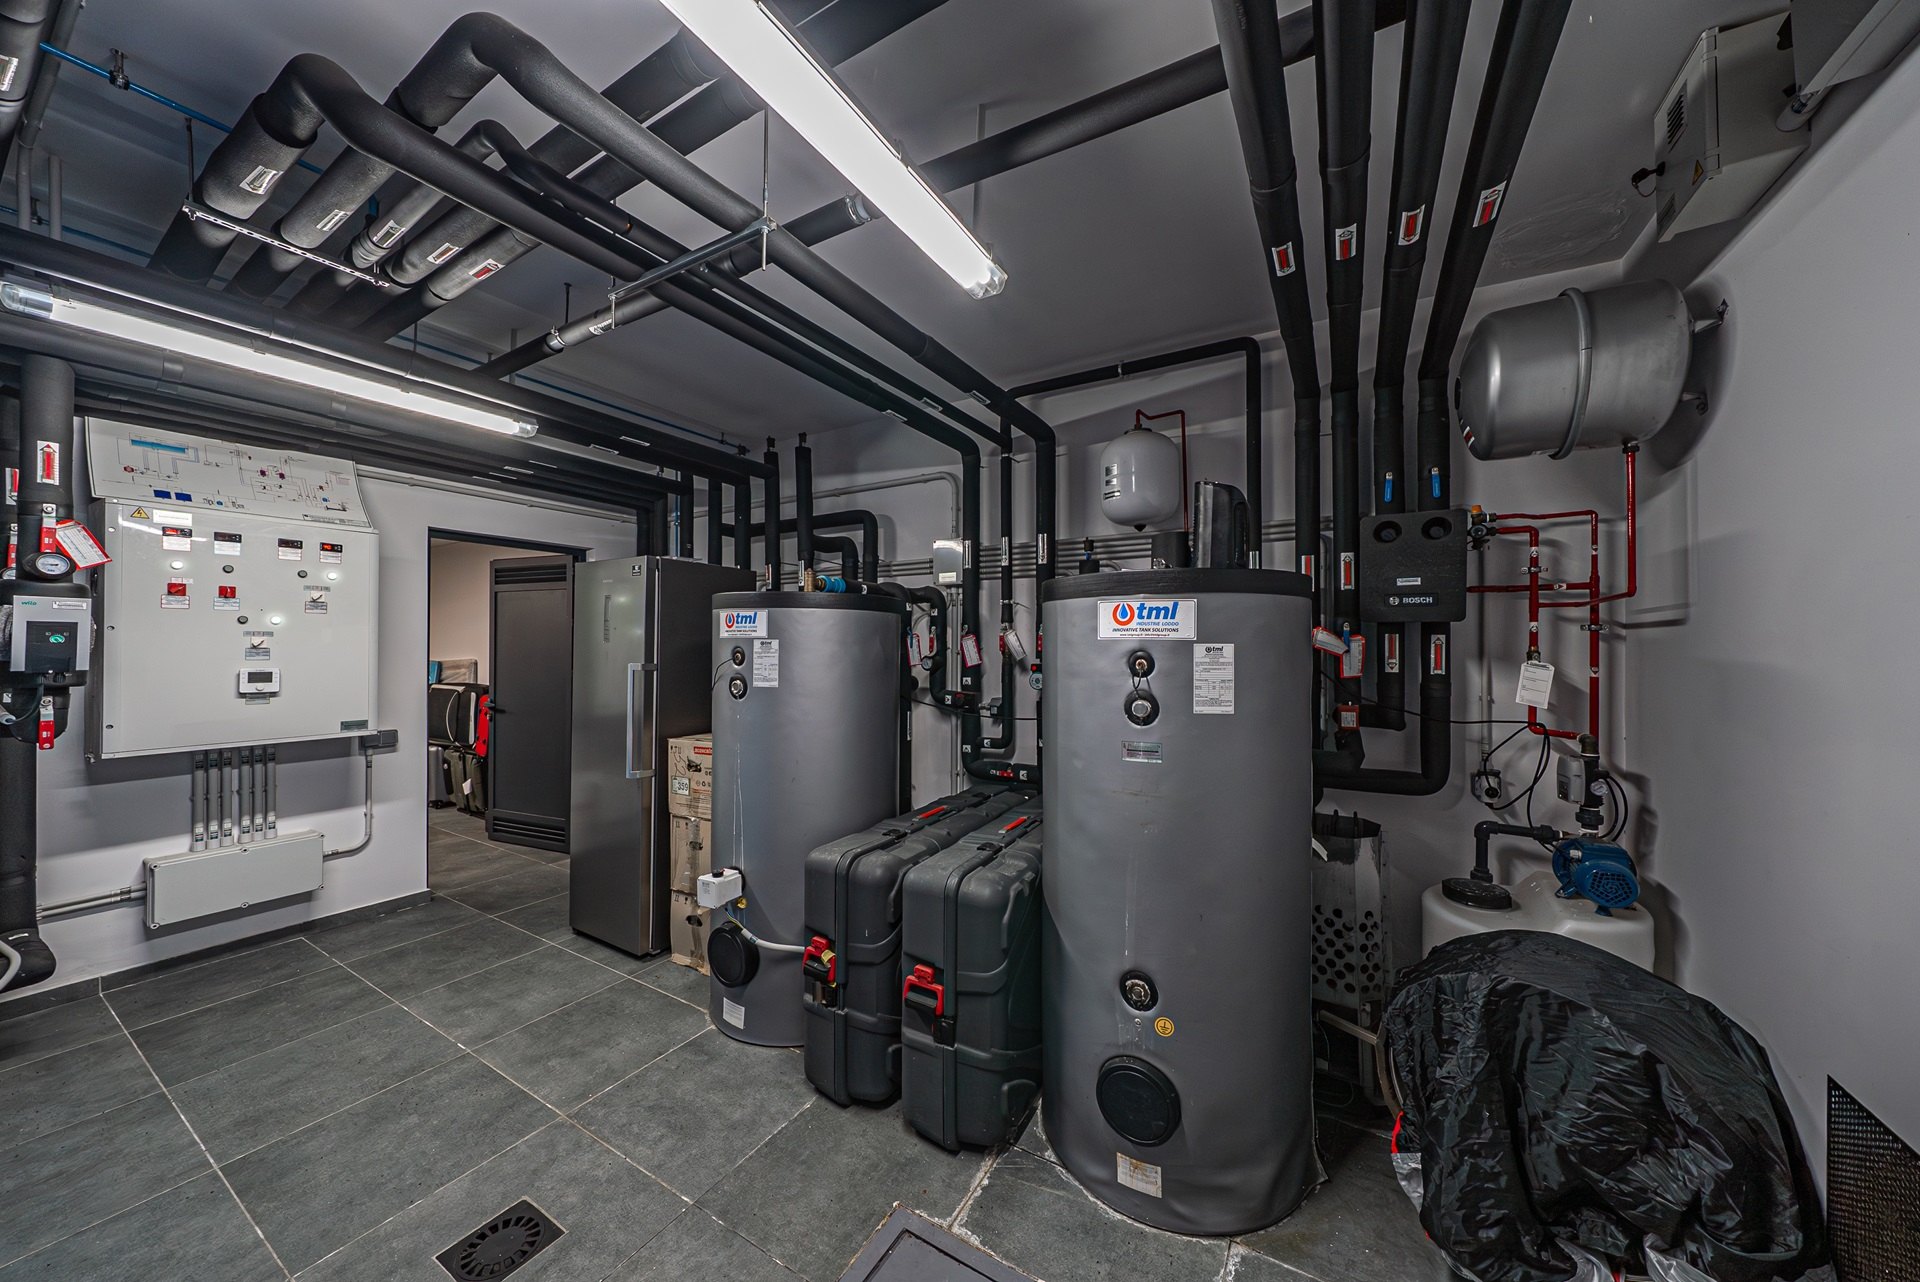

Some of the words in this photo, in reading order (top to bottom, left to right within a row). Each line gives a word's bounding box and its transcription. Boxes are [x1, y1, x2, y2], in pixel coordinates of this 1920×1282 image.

[1136, 601, 1179, 619] tml
[736, 612, 758, 624] tml
[678, 782, 688, 792] 359
